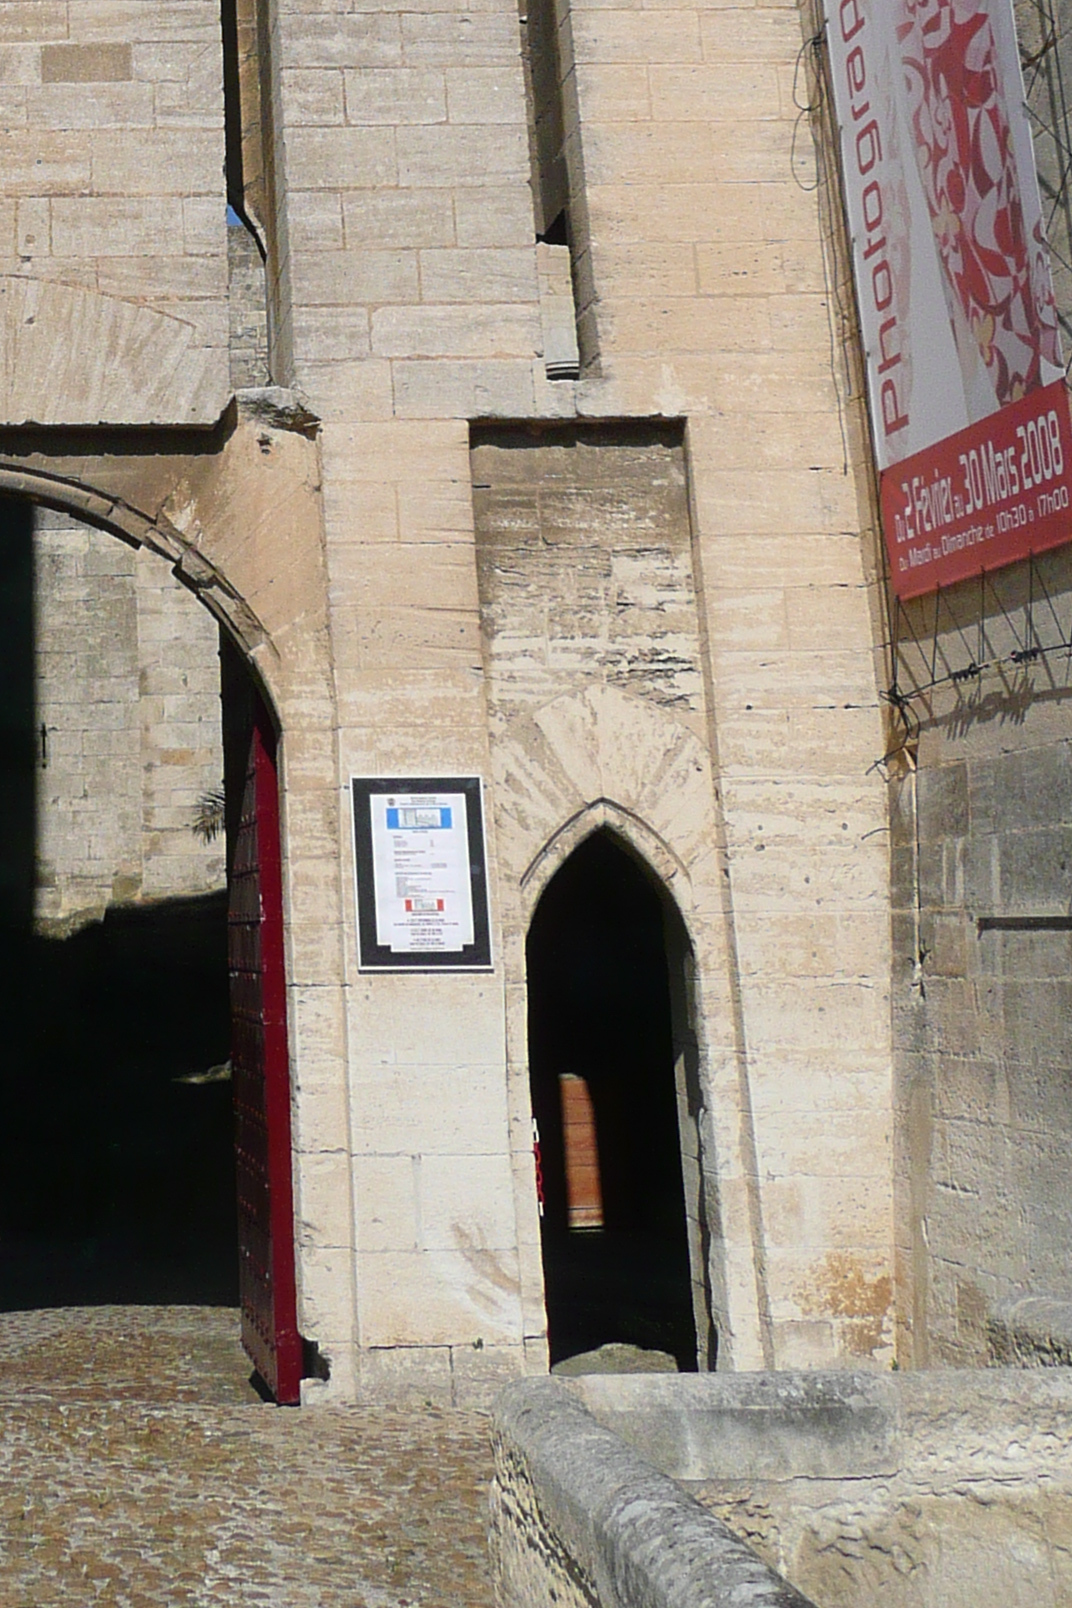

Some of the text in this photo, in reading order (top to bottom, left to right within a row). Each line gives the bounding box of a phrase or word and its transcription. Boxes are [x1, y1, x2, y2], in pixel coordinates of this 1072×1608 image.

[959, 449, 983, 515] 30
[980, 440, 1020, 506] Mars
[1016, 410, 1064, 490] 2008
[901, 482, 915, 539] 2
[909, 543, 933, 568] Mardi
[941, 524, 985, 556] Dimanche
[984, 523, 995, 539] de
[996, 503, 1027, 534] 10h30
[1036, 485, 1069, 518] 17h00
[912, 468, 955, 535] Février
[954, 494, 965, 519] au
